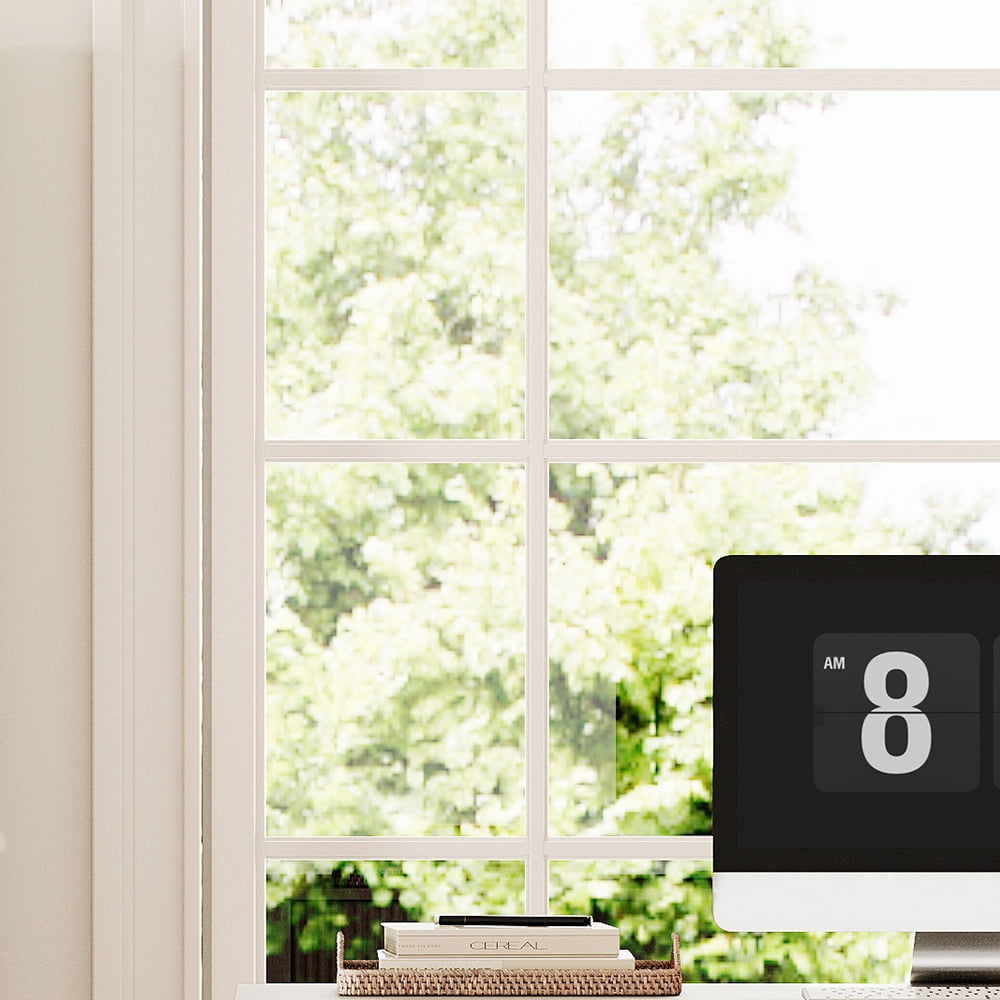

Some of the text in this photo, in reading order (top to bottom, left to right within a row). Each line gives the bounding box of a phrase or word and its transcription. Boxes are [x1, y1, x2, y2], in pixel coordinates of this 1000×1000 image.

[823, 656, 846, 670] AM
[861, 651, 932, 775] 8
[469, 941, 549, 951] CEREAL
